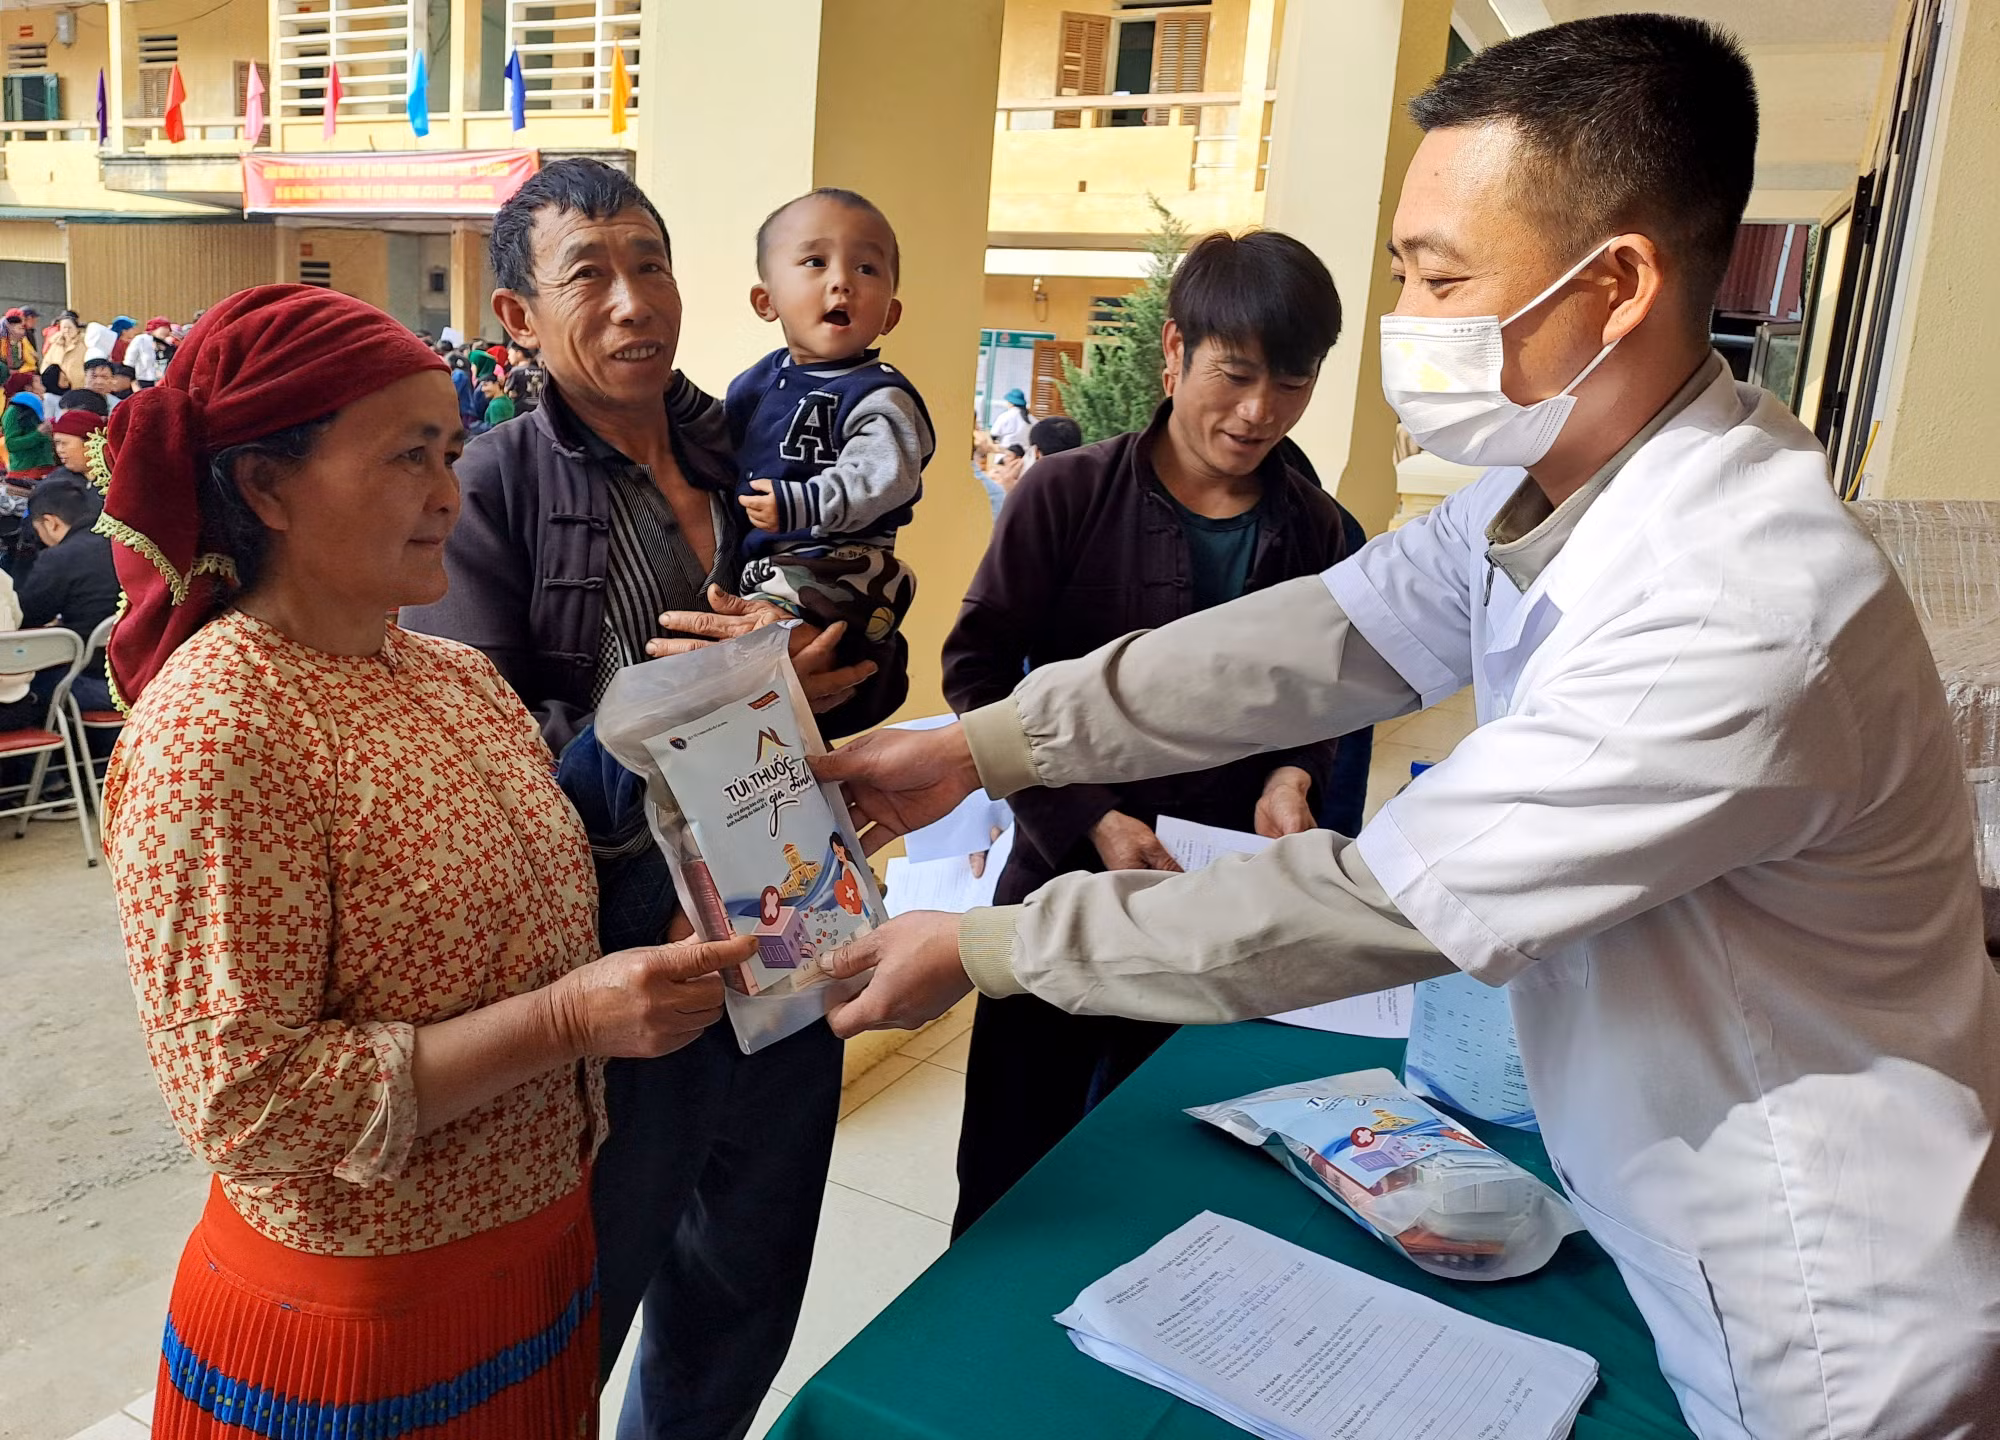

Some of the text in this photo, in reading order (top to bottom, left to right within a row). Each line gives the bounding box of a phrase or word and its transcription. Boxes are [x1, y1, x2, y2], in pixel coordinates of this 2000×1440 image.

[780, 389, 839, 464] A
[723, 753, 795, 802] TÚI THUỐC
[769, 789, 798, 837] gia
